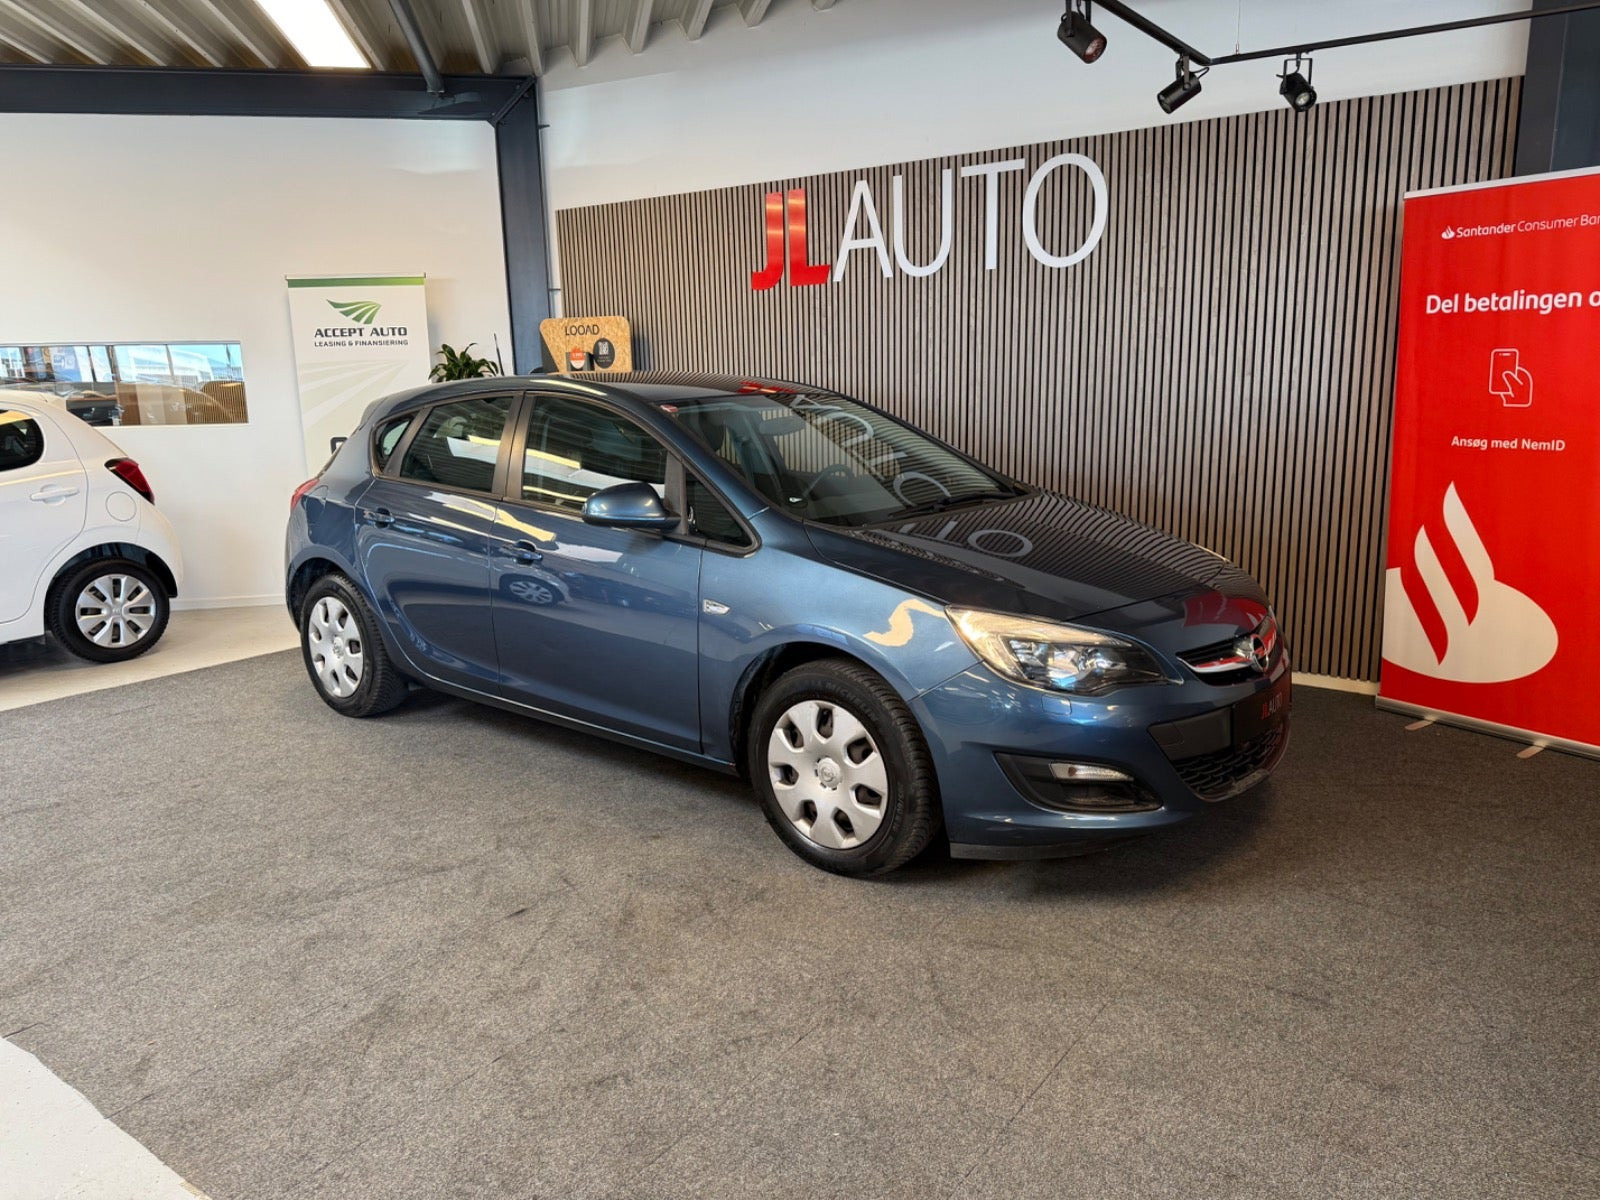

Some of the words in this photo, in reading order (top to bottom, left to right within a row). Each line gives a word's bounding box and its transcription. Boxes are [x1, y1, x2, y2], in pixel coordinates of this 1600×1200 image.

[1456, 222, 1516, 238] Santander
[1517, 216, 1579, 232] Consumer
[1425, 293, 1459, 314] Del
[1464, 289, 1582, 315] betalingen
[314, 328, 364, 338] ACCEPT
[370, 327, 408, 337] AUTO
[1451, 435, 1488, 450] Ansøg
[1491, 438, 1518, 449] med
[1521, 438, 1566, 451] NemID
